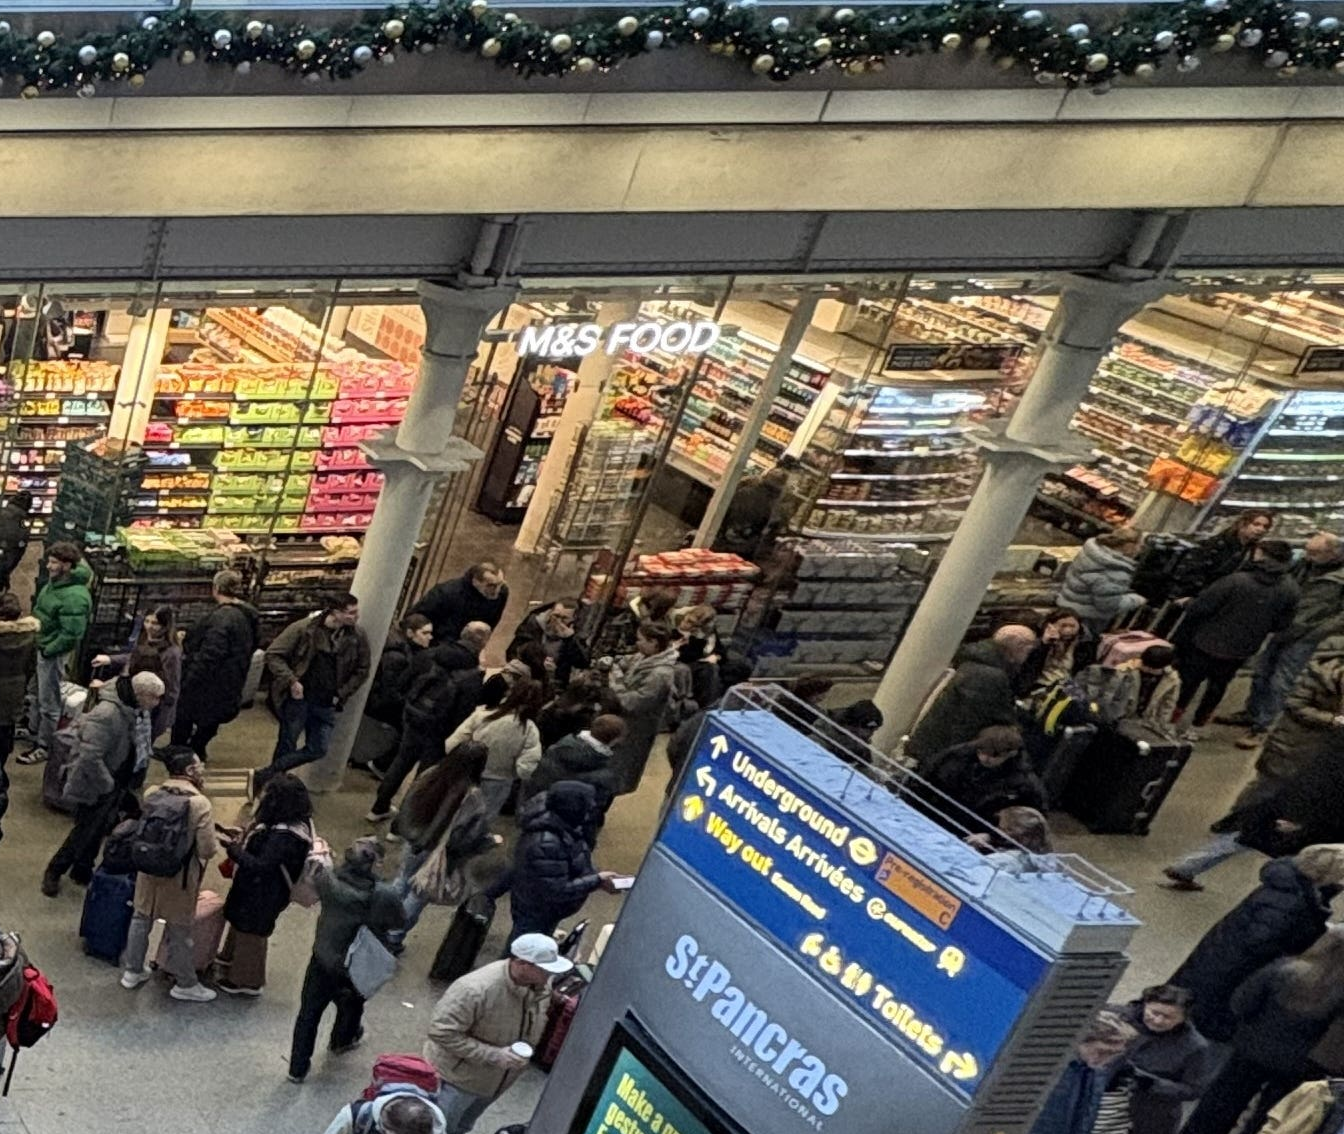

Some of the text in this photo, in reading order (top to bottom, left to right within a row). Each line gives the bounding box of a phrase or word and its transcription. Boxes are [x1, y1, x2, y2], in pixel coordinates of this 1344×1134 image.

[518, 320, 720, 357] M&S FOOD
[732, 751, 850, 847] Underground
[706, 812, 774, 876] Way out
[718, 784, 788, 845] Arrivals
[784, 834, 866, 904] Arrivées
[938, 910, 952, 926] C
[872, 984, 944, 1057] Toilets
[616, 1073, 654, 1123] Make
[650, 1112, 665, 1134] a
[729, 1046, 825, 1132] INTERNATIONAL
